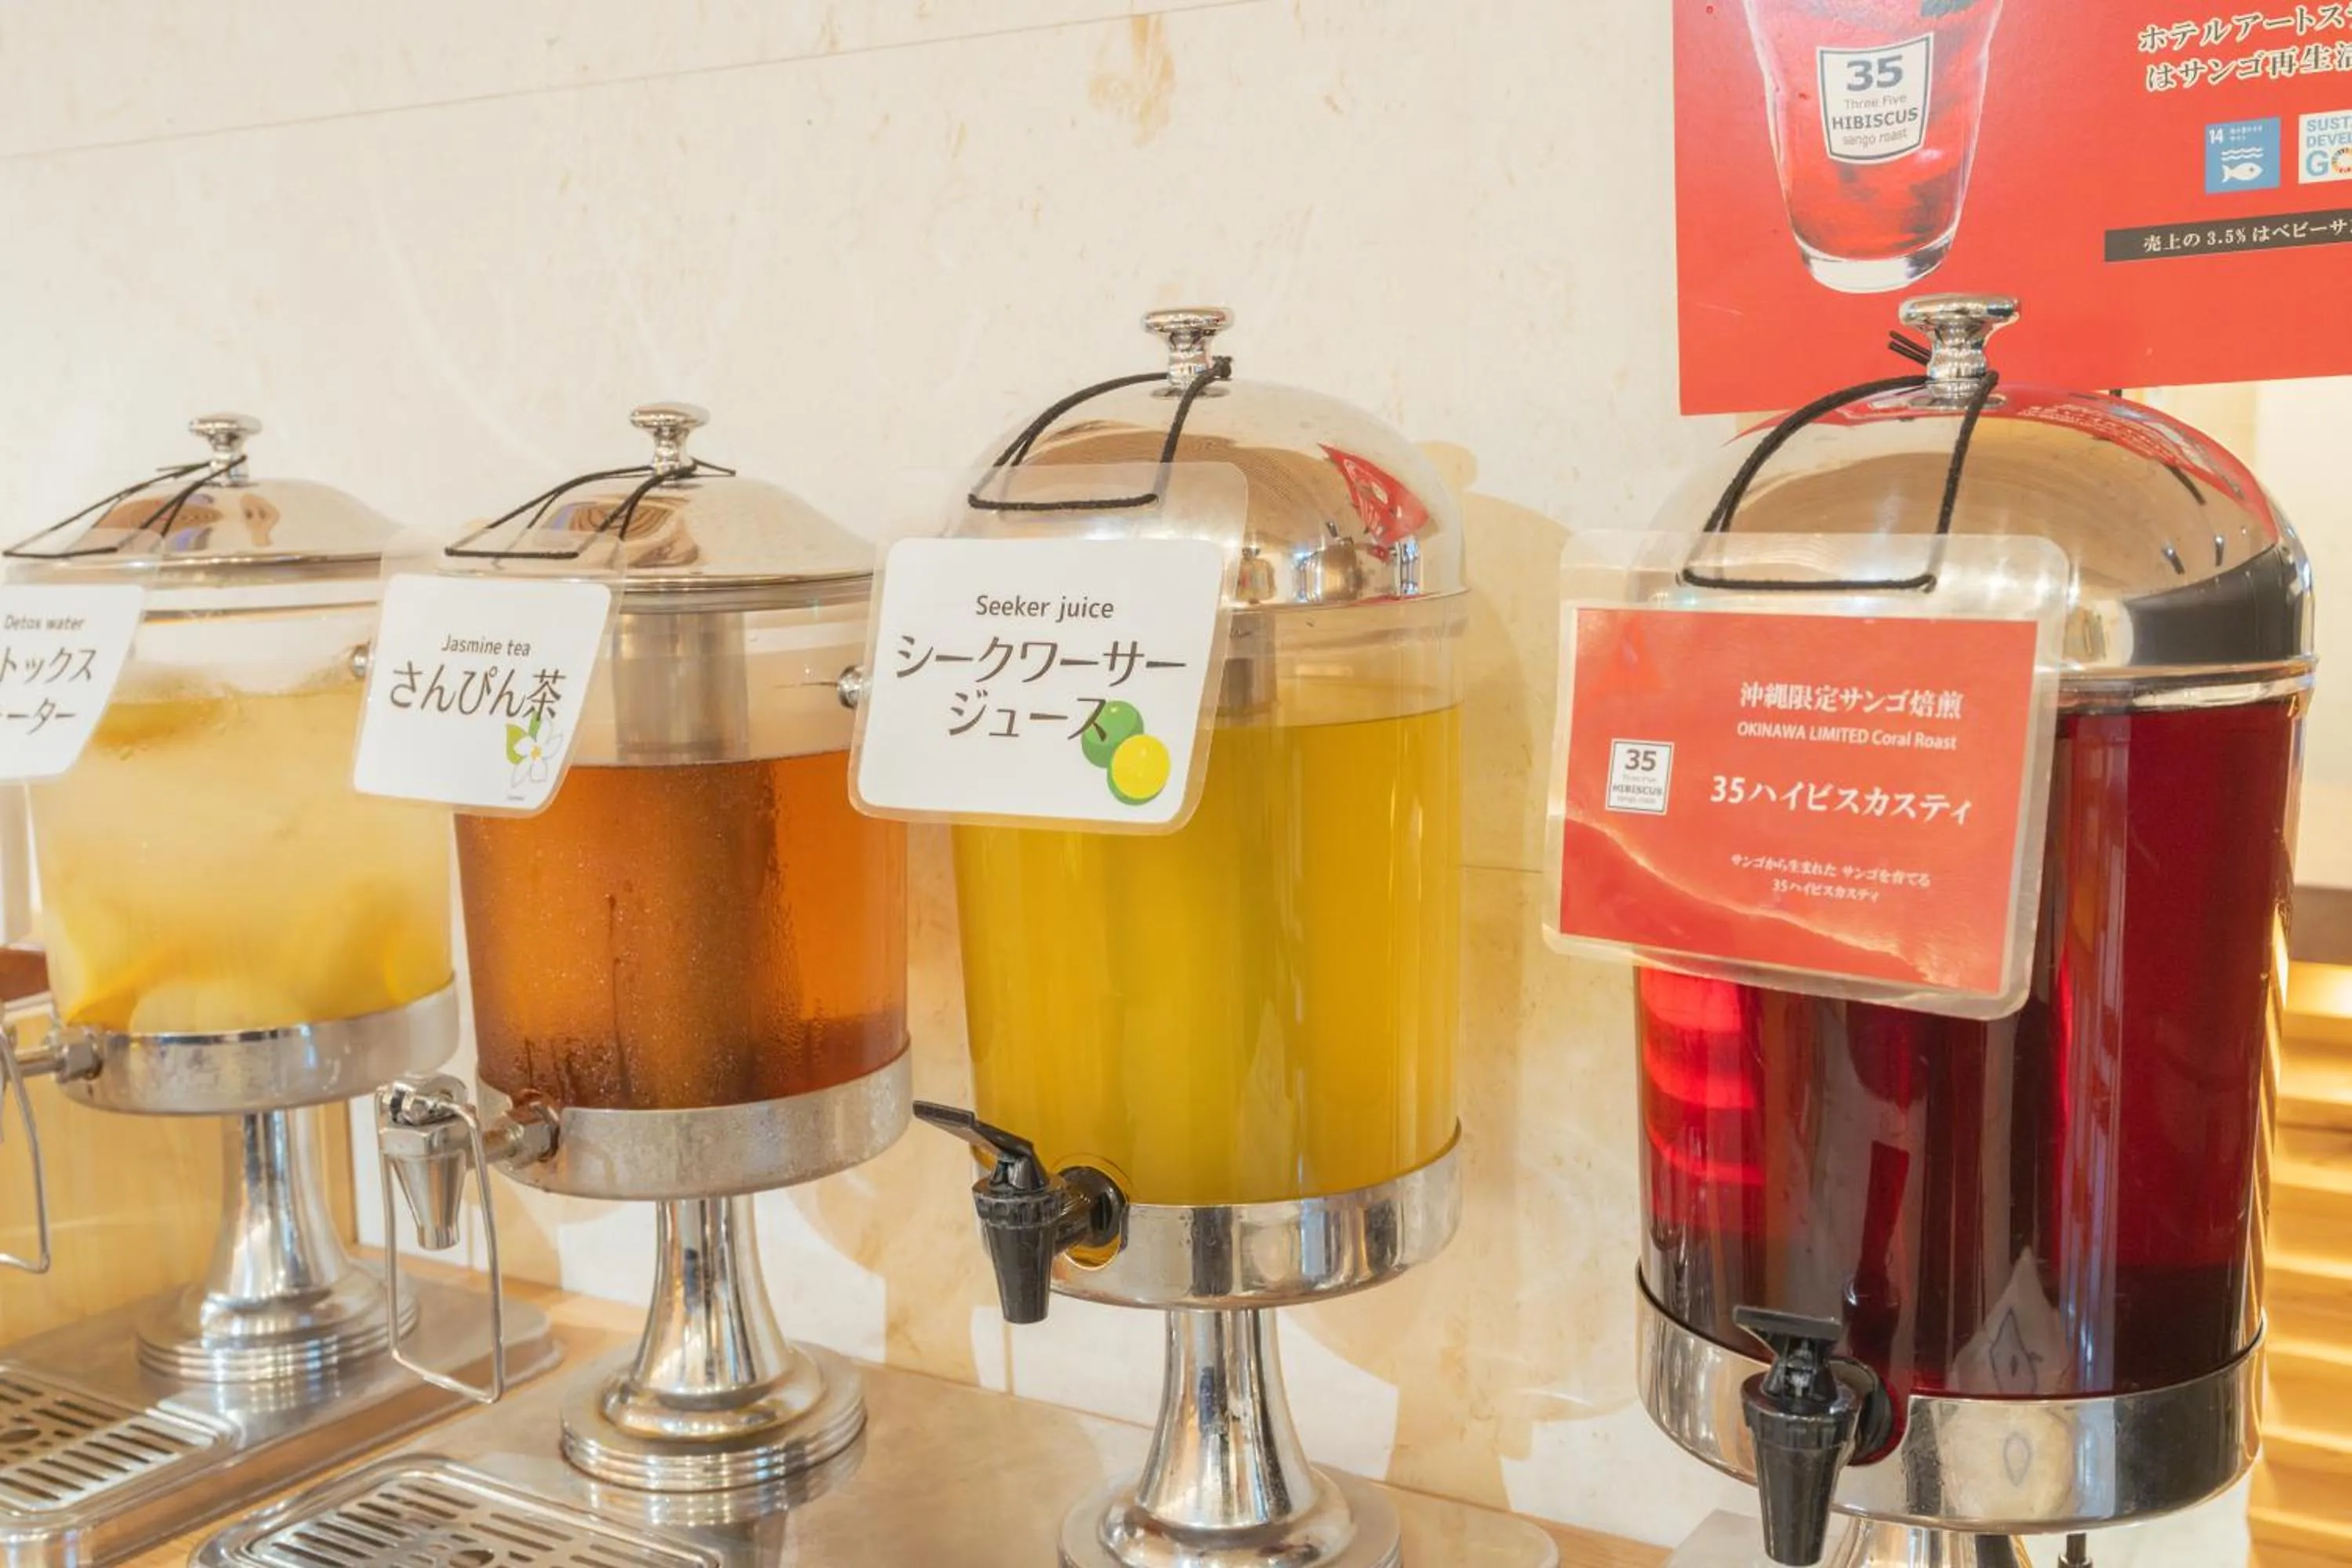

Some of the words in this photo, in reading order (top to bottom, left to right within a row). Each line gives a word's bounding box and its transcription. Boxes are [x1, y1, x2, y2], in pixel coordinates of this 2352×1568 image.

[1846, 54, 1903, 92] 35
[1844, 98, 1878, 109] Three
[1882, 95, 1907, 106] Five
[1832, 107, 1918, 130] HIBISCUS
[2307, 115, 2352, 132] SUST
[1842, 135, 1876, 148] sango
[1878, 129, 1907, 143] roast
[2209, 128, 2223, 144] 14
[2143, 233, 2201, 253] 売上の
[2207, 227, 2247, 245] 3.5%
[2252, 218, 2352, 241] はベビーサ
[975, 594, 1051, 617] Seeker
[1055, 596, 1114, 622] juice
[4, 615, 42, 630] Detox
[45, 617, 85, 630] water
[441, 634, 502, 655] Jasmine
[506, 639, 532, 657] tea
[895, 634, 1188, 688] シークワーサー
[389, 660, 567, 721] さんぴん茶
[1740, 681, 1964, 719] 沖縄限定サンゴ焙煎
[0, 697, 76, 735] ーター
[948, 689, 1108, 742] ジュース
[1737, 721, 1806, 739] OKINAWA
[1809, 726, 1869, 743] LIMITED
[1871, 729, 1911, 747] Coral
[1915, 732, 1958, 750] Roast
[1625, 748, 1657, 771] 35
[1710, 775, 1973, 826] 35ハイビスカスティ
